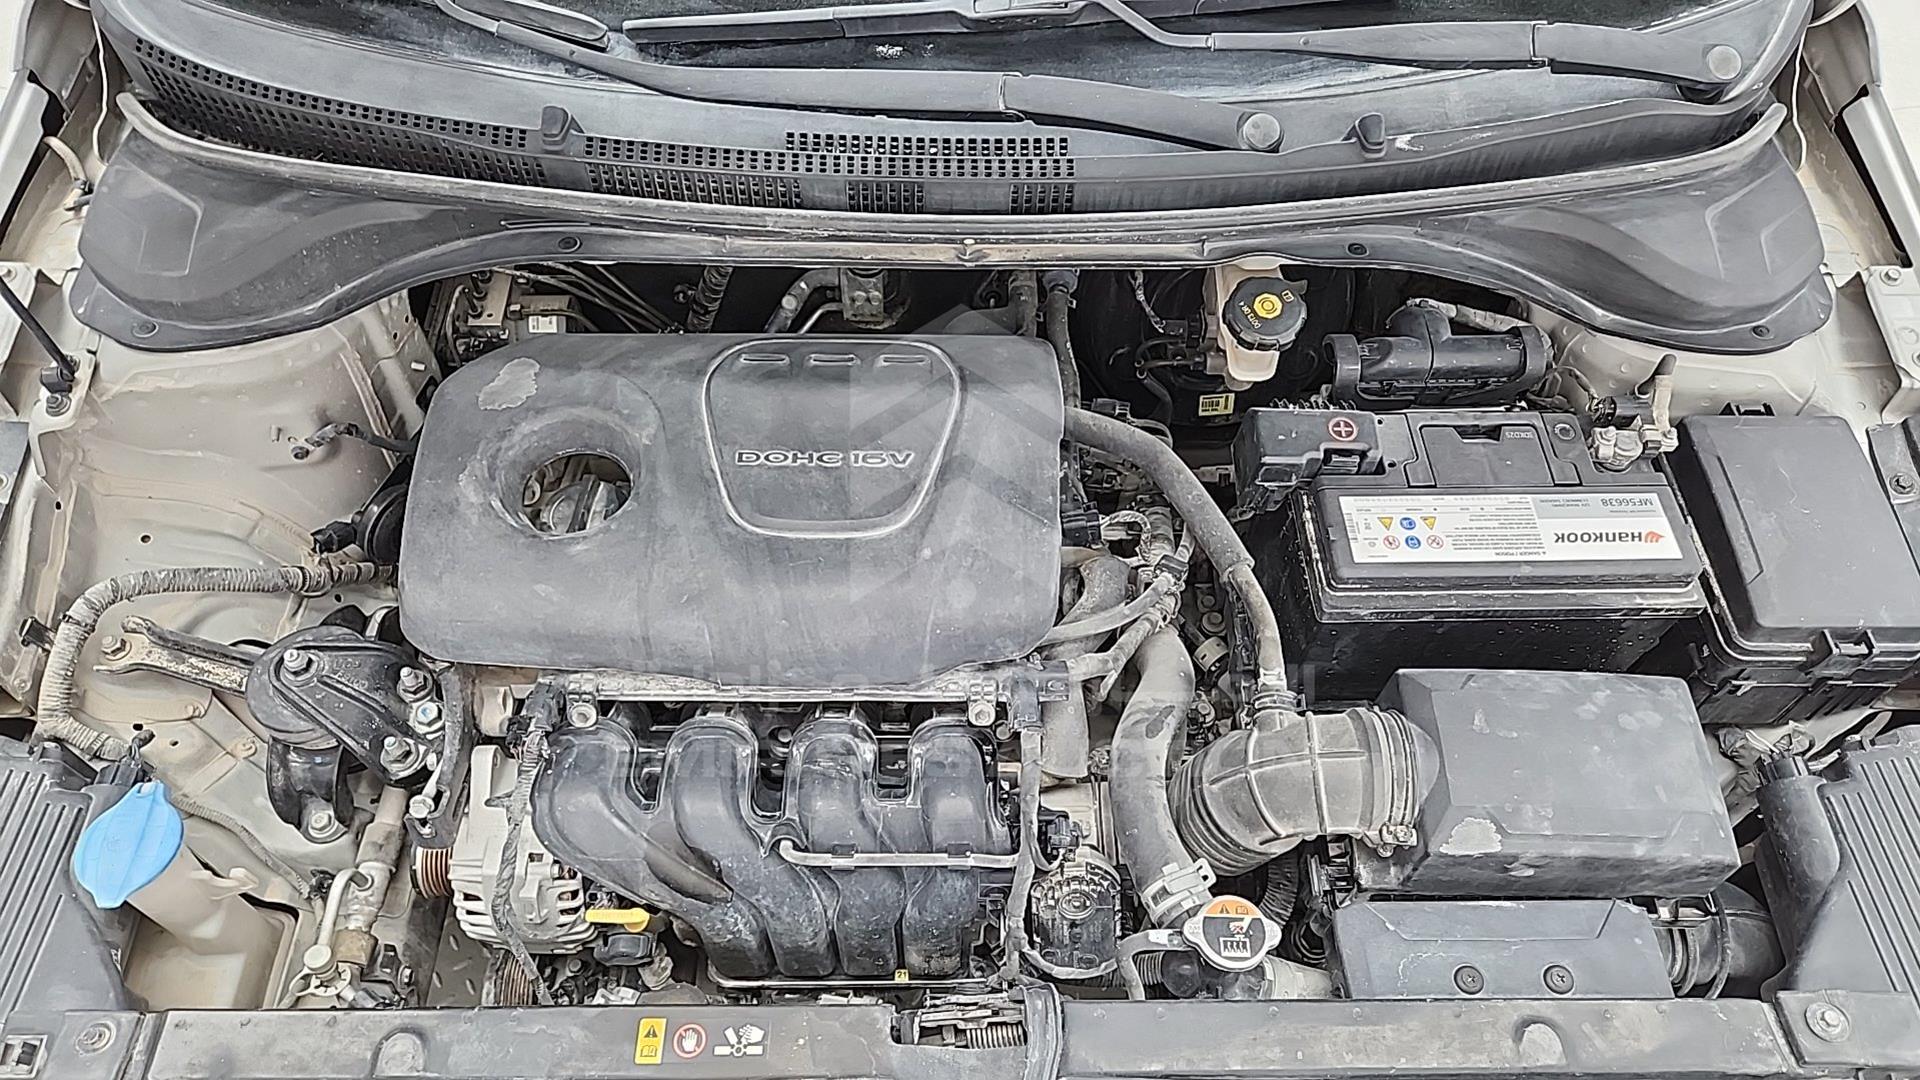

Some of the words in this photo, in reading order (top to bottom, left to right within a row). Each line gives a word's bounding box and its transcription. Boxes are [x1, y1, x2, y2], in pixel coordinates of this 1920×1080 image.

[735, 449, 842, 467] DOHC
[851, 449, 915, 468] 16V
[1600, 498, 1654, 507] MF56638
[896, 970, 907, 979] 21
